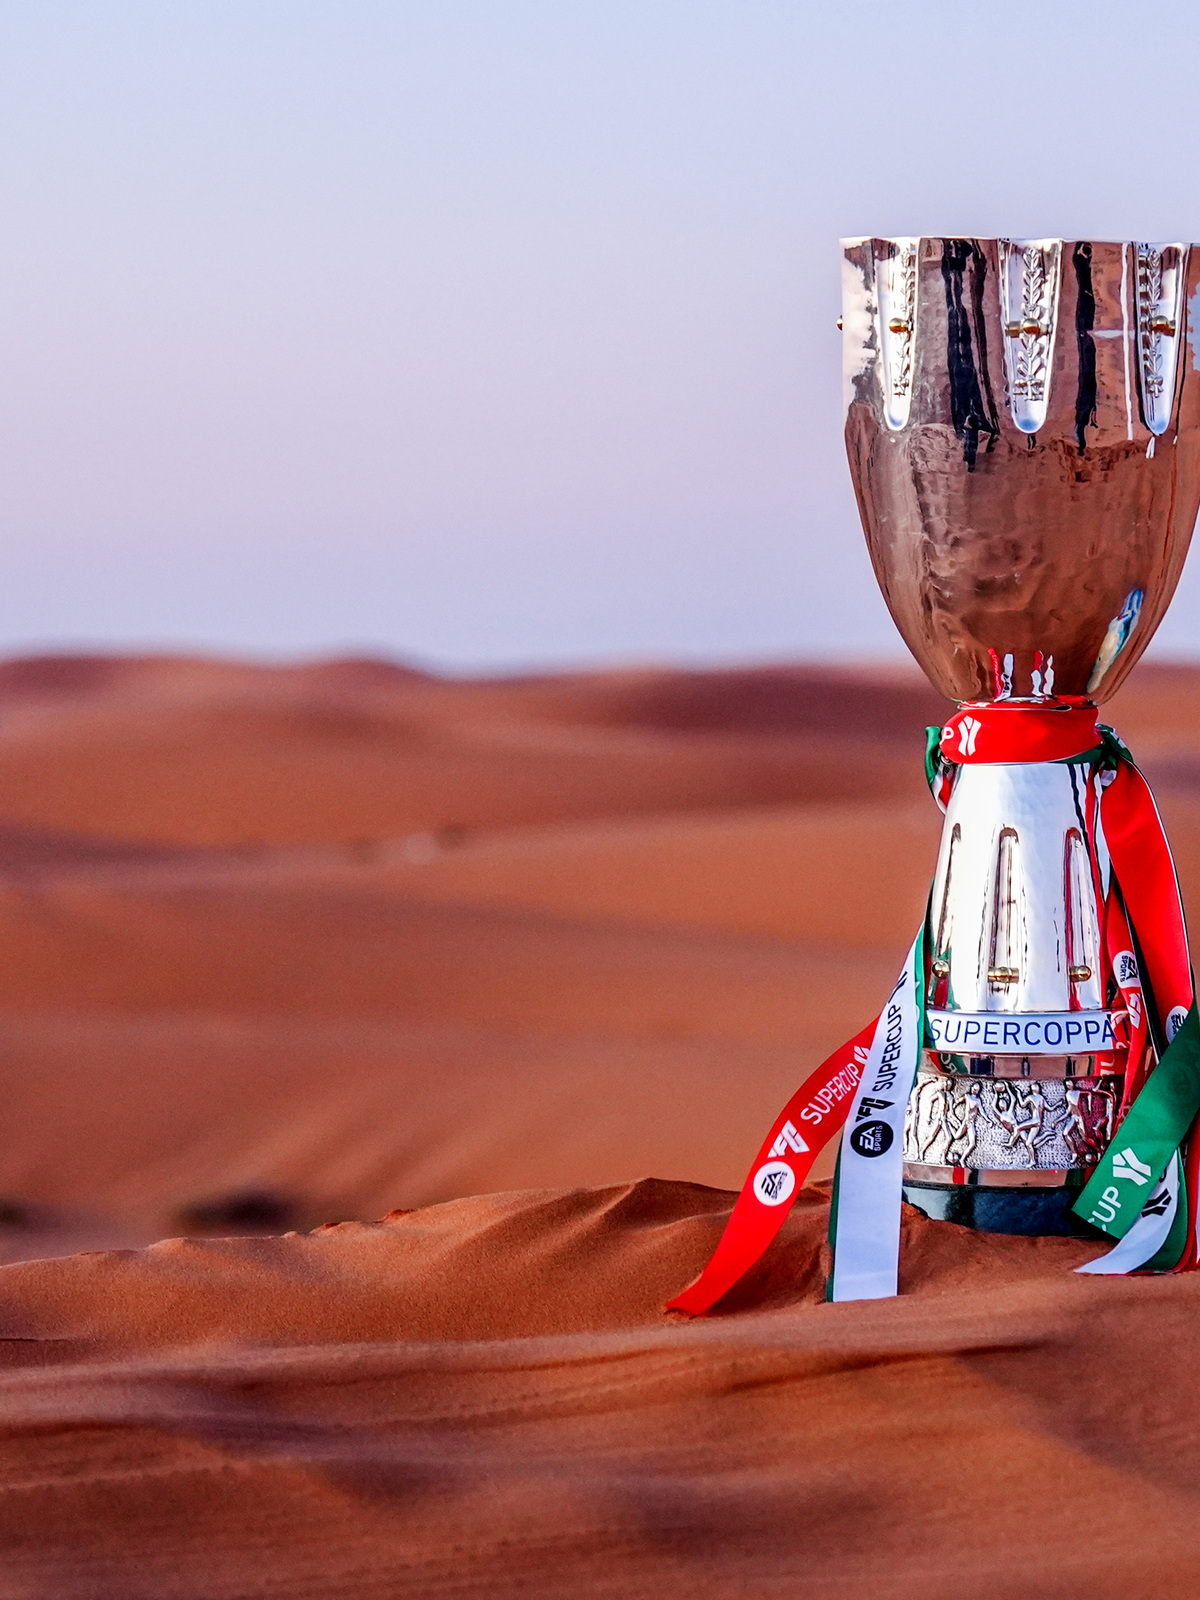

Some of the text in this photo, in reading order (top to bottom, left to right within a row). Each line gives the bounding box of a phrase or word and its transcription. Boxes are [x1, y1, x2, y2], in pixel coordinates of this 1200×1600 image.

[928, 1018, 1117, 1046] SUPERCOPPA
[872, 1004, 903, 1092] SUPERCUP
[800, 1062, 862, 1125] SUPERCUP
[859, 1126, 876, 1151] EA
[873, 1125, 884, 1152] SPORTS
[761, 1171, 782, 1197] EA
[1088, 1186, 1121, 1231] UP
